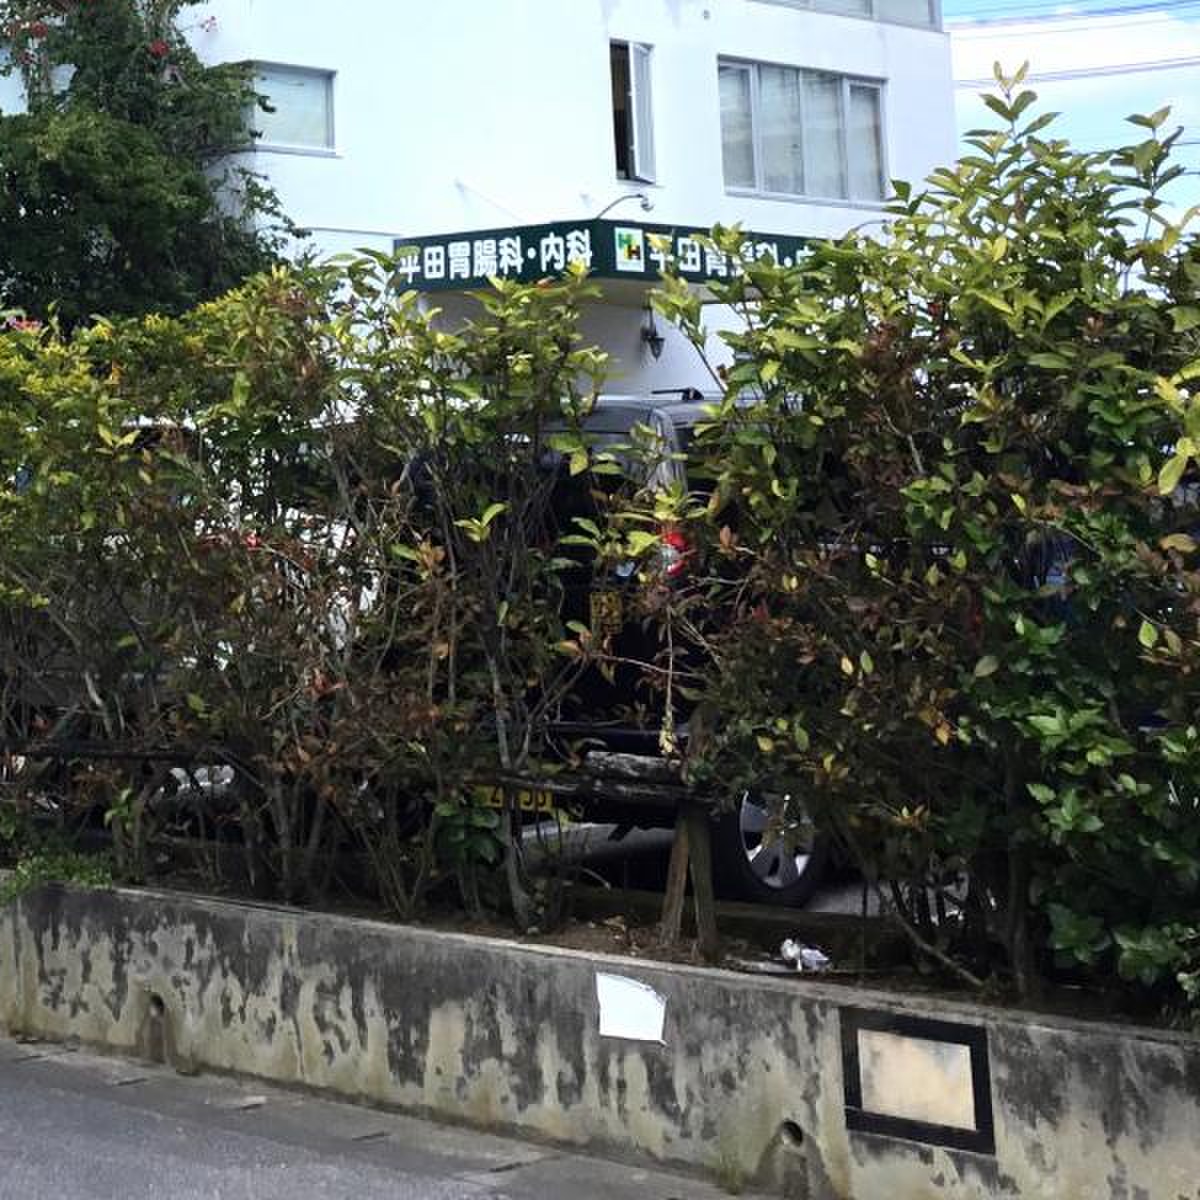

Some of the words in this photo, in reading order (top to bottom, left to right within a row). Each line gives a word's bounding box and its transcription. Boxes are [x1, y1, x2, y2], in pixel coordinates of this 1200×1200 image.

[398, 229, 592, 283] 平田胃腸科・内科
